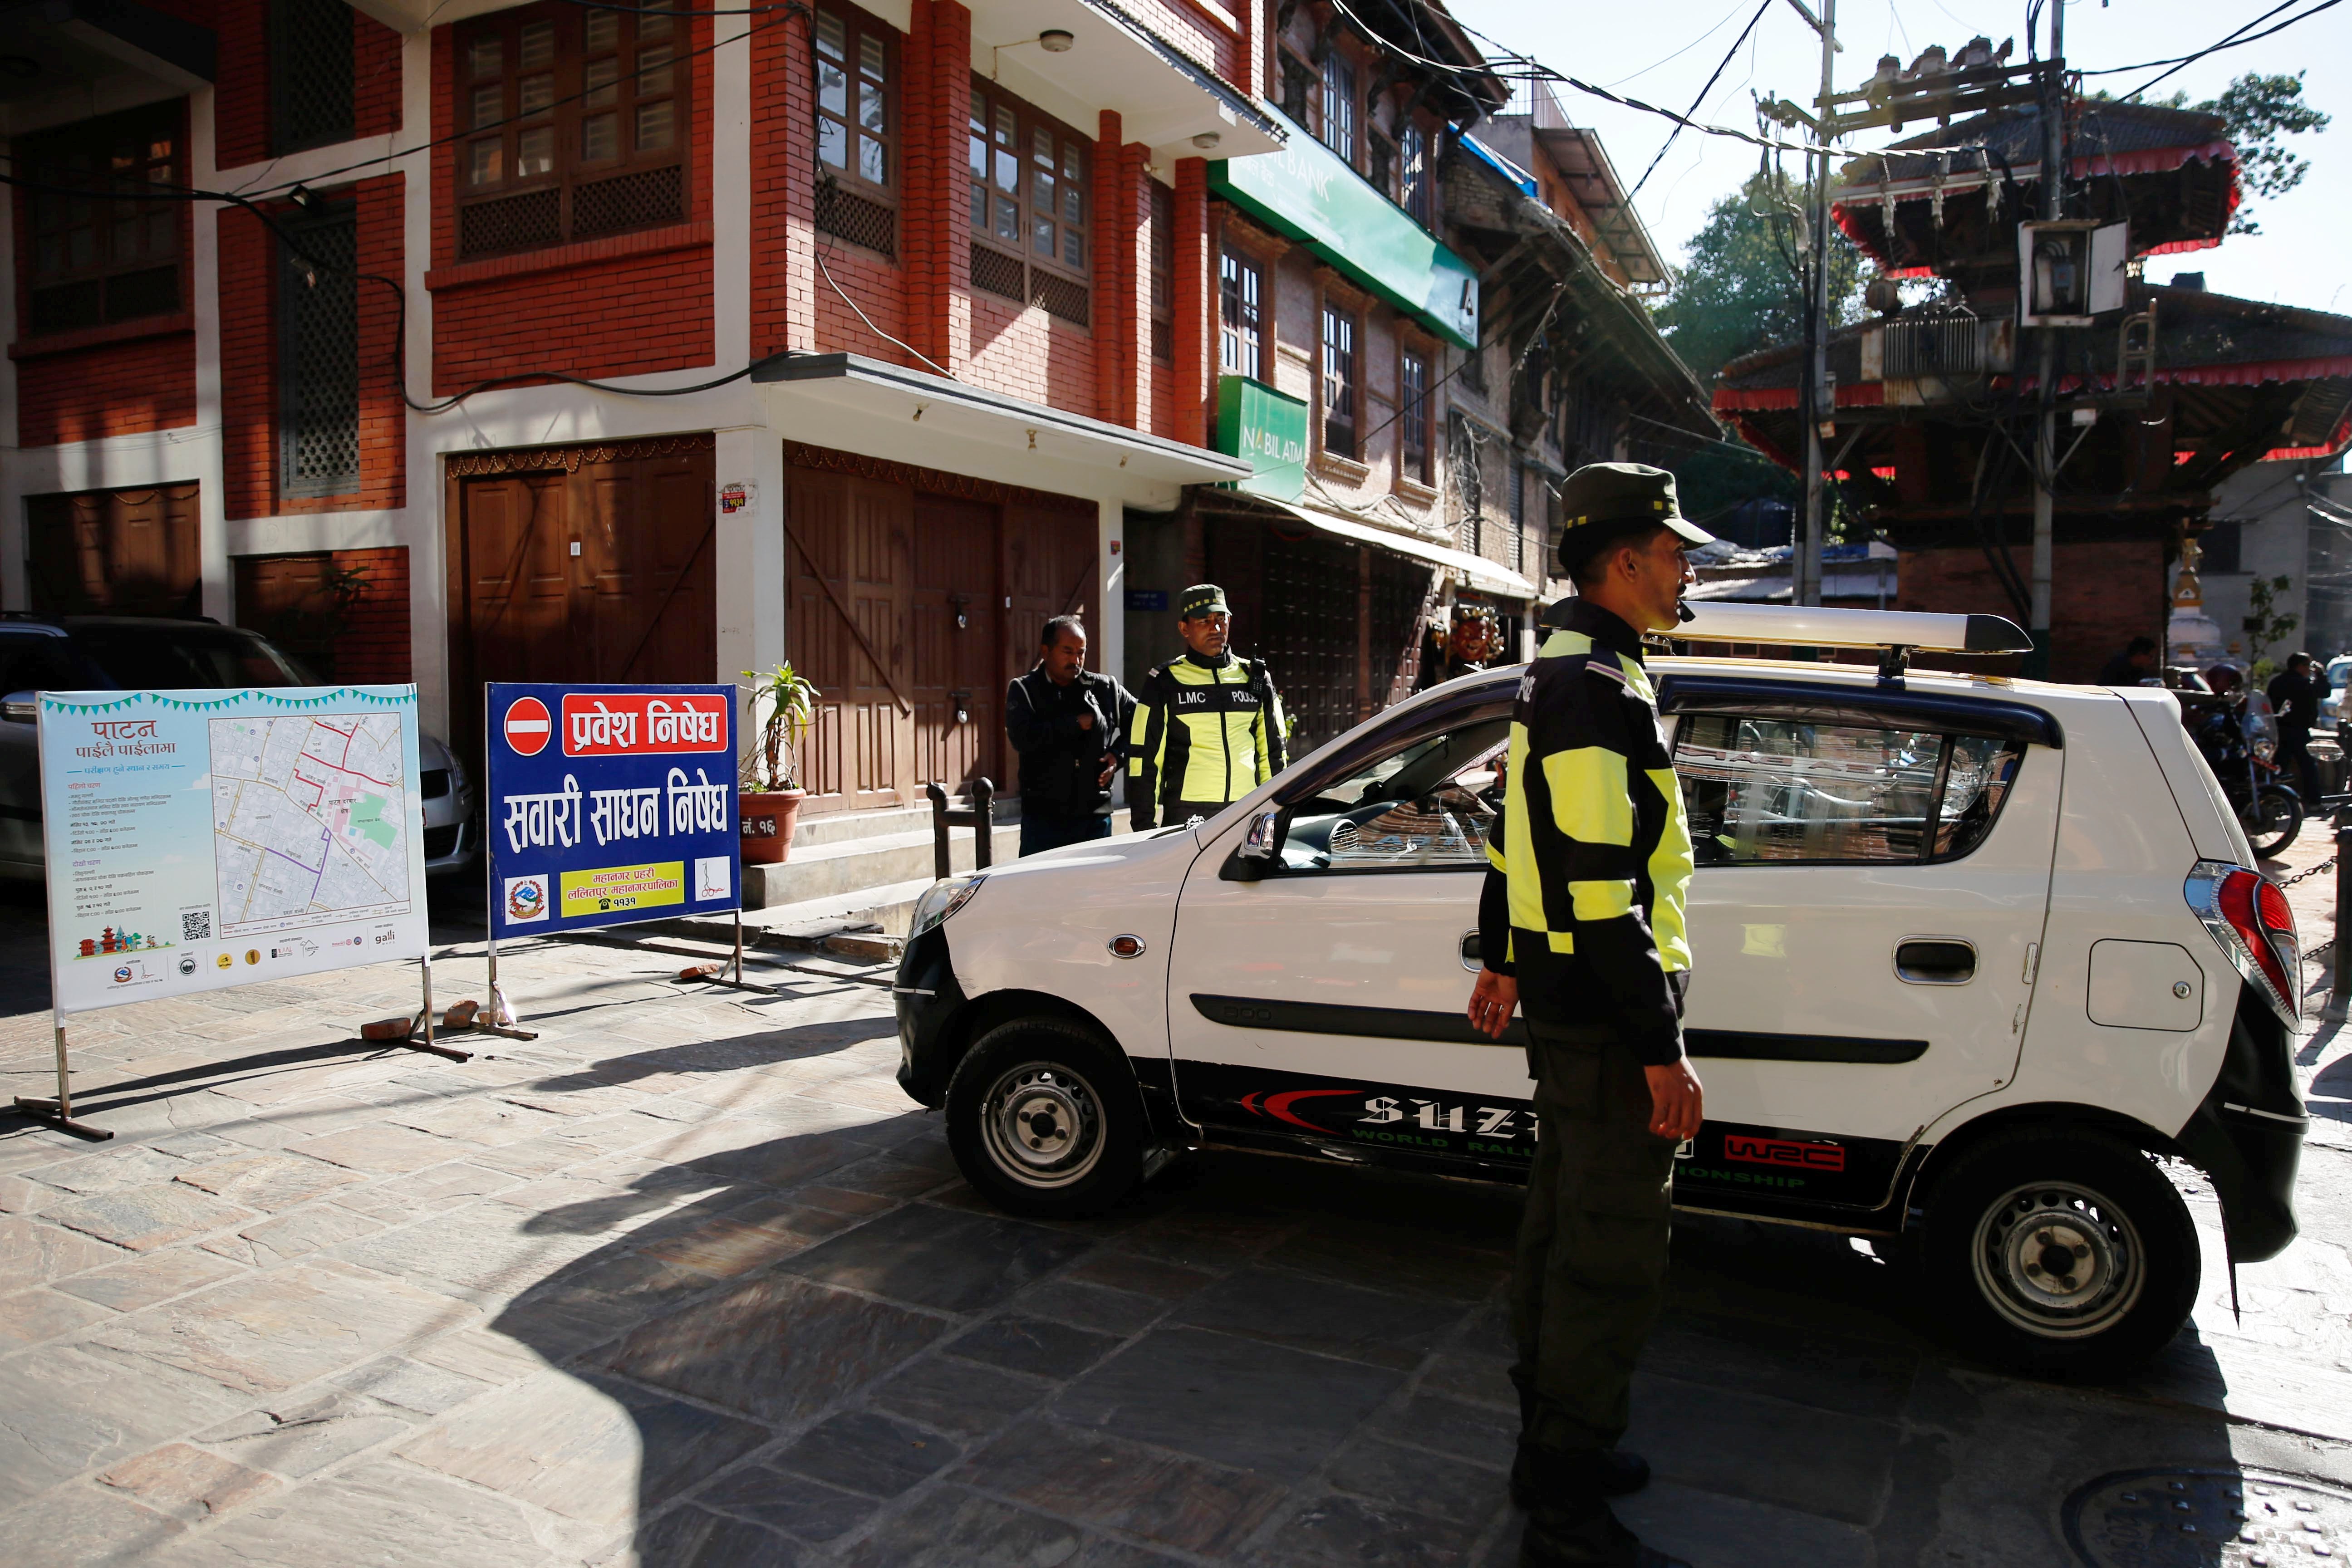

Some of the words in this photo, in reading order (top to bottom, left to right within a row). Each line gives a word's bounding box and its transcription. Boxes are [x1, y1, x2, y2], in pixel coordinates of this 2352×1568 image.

[1287, 146, 1329, 202] BANK
[1243, 425, 1280, 459] NABIL
[1282, 439, 1303, 465] ATM
[1178, 692, 1206, 704] LMC
[91, 720, 158, 740] पाटन
[570, 701, 638, 752] प्रवेश
[647, 700, 720, 744] निषेध
[75, 741, 114, 758] पाईलै
[118, 740, 176, 756] पाईलामा
[504, 774, 583, 854] सवारी
[590, 787, 661, 846] साधन
[667, 767, 728, 837] निषेध
[759, 820, 776, 835] १६
[593, 870, 631, 885] महानगर
[633, 867, 655, 883] प्रहरी
[567, 887, 608, 902] ललितपुर
[611, 878, 678, 896] महानगरपालिका
[614, 897, 636, 907] ११३१
[375, 930, 395, 944] galli
[1352, 1128, 1448, 1147] WORLD
[1468, 1142, 1534, 1157] RALL
[1679, 1165, 1805, 1188] IONSHIP
[1728, 1140, 1841, 1166] WRC
